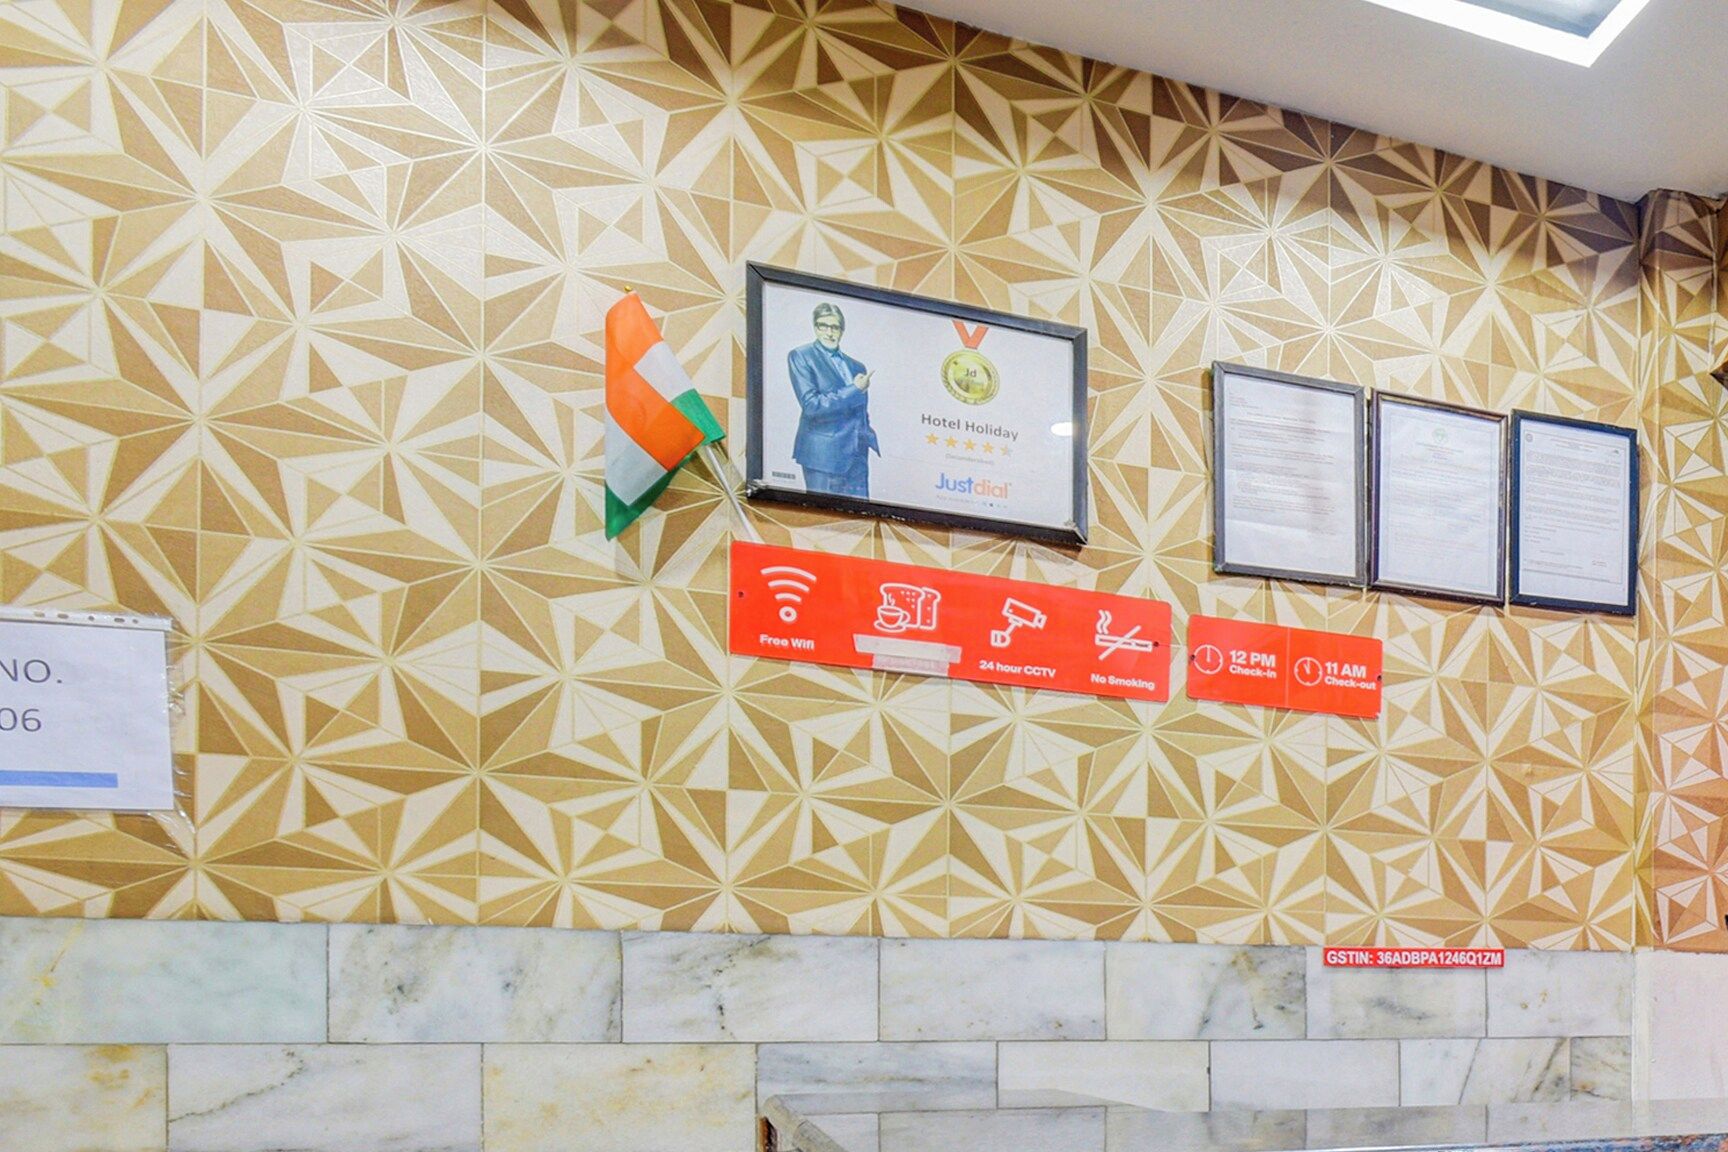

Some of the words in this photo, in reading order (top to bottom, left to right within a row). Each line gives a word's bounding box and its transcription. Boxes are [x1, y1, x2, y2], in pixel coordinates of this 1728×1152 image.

[921, 414, 961, 430] Hotel
[965, 421, 1019, 441] Holiday
[935, 473, 1009, 498] Justdial
[760, 633, 787, 648] Free
[790, 638, 815, 651] Wifi
[1229, 650, 1246, 664] 12
[1250, 653, 1276, 667] PM
[0, 659, 62, 683] NO.
[979, 660, 995, 673] 24
[996, 662, 1021, 677] hour
[1023, 665, 1056, 679] CCTV
[1229, 664, 1277, 678] Check-in
[1325, 661, 1339, 674] 11
[1341, 664, 1367, 678] AM
[1091, 673, 1105, 685] No
[1108, 677, 1155, 690] Smoking
[1325, 675, 1376, 689] Check-out
[1326, 950, 1374, 965] GSTIN:
